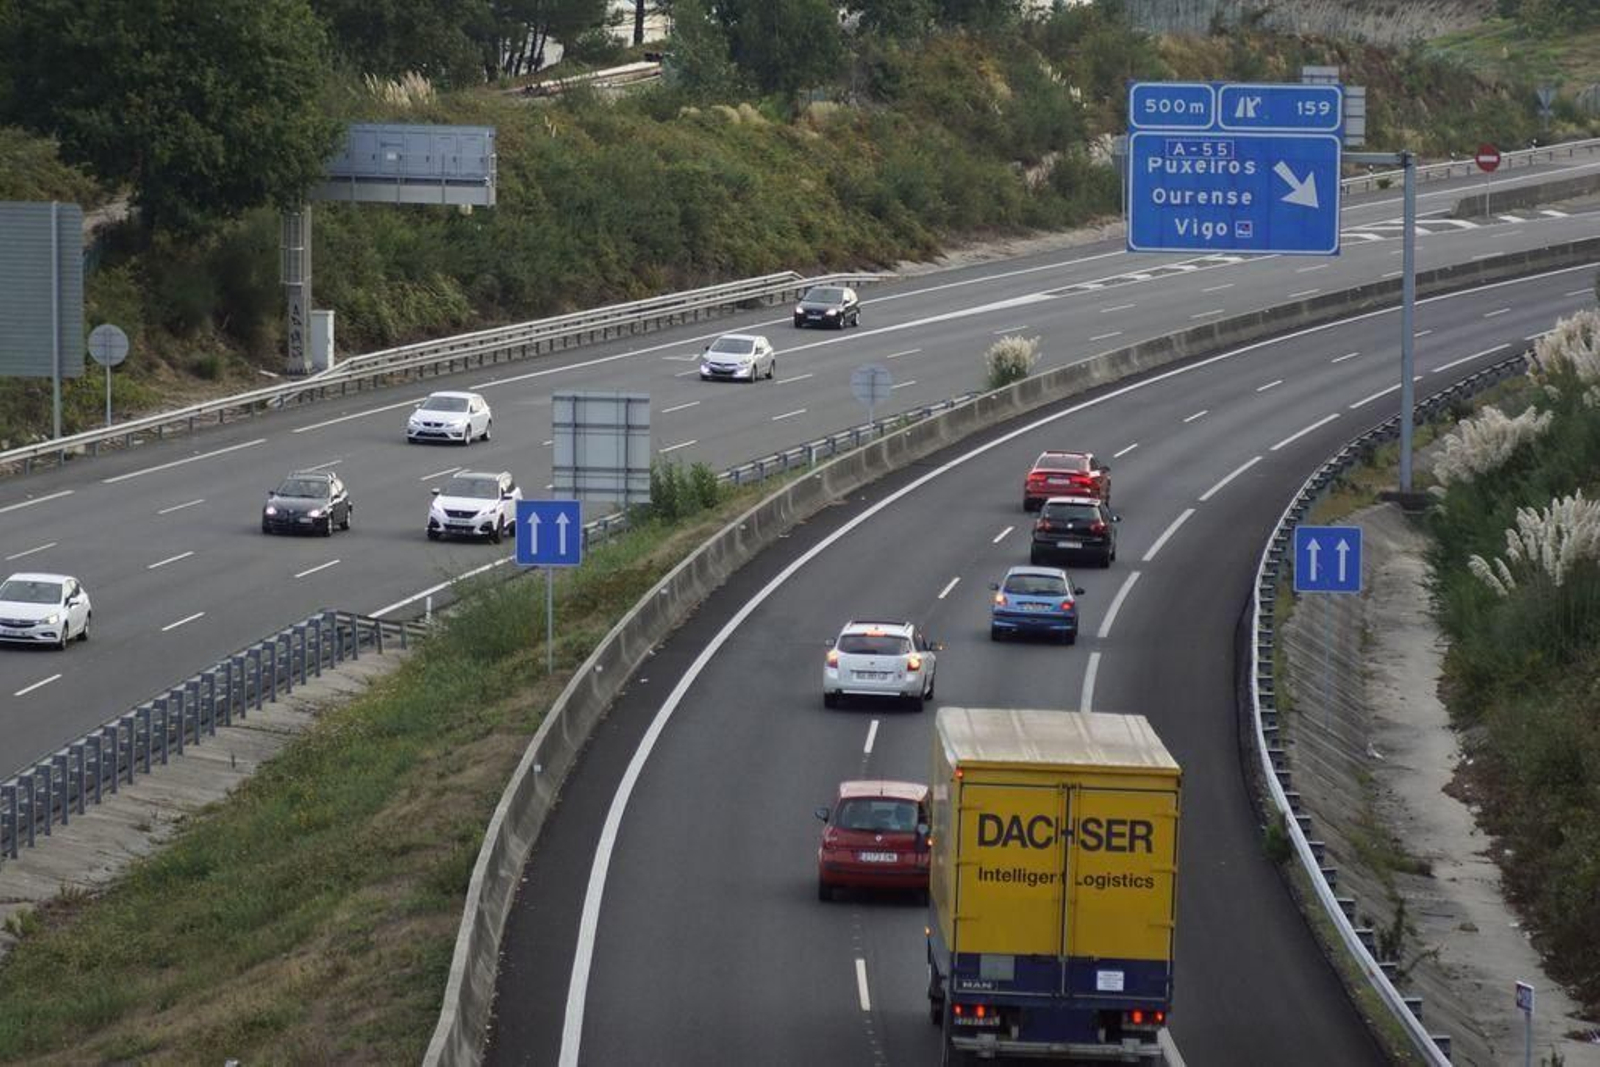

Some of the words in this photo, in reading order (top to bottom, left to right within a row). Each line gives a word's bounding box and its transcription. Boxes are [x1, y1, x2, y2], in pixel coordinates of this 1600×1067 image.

[1297, 101, 1331, 116] 159
[1172, 142, 1228, 156] A-55
[1148, 157, 1256, 175] Puxeiros
[1152, 188, 1253, 205] Ourense
[1174, 218, 1228, 240] Vigo
[977, 813, 1154, 854] DACHSER
